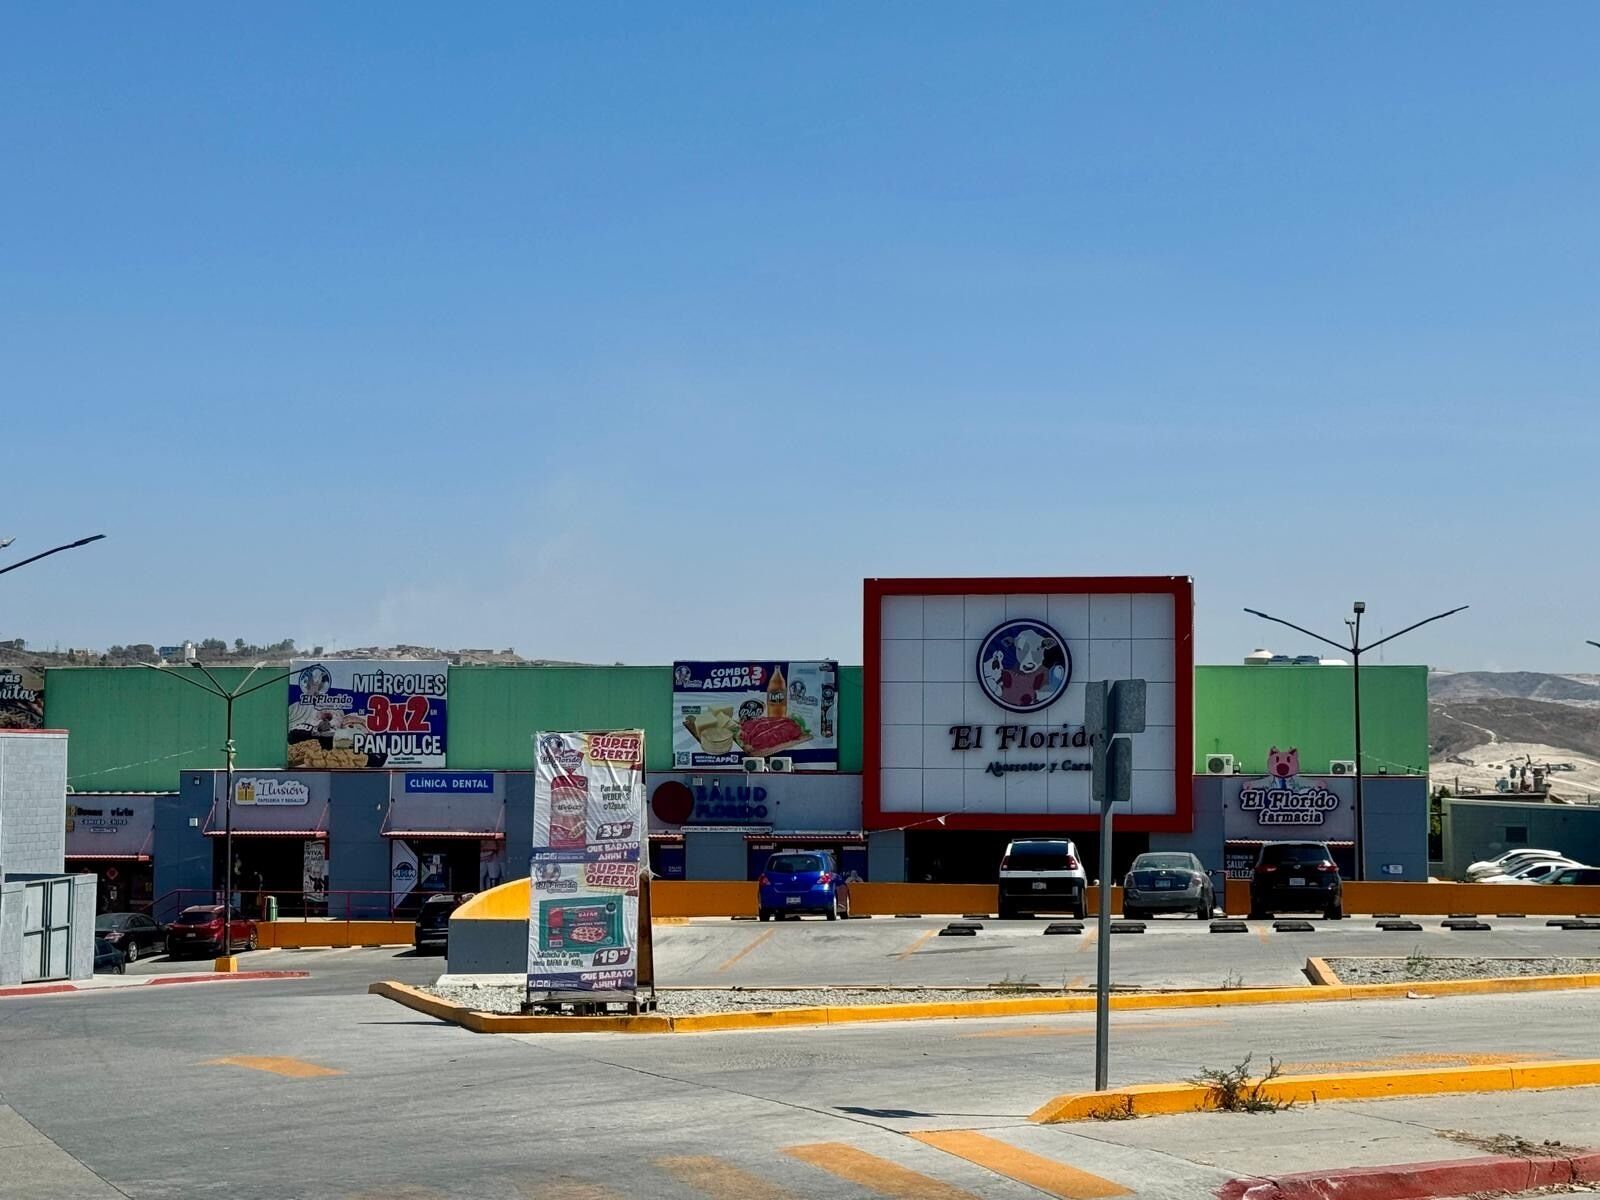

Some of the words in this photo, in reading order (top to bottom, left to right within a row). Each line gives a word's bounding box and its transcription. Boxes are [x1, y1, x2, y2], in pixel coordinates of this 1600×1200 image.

[710, 666, 749, 678] COMBO
[353, 669, 446, 696] MIÉRCOLES
[703, 677, 751, 690] ASADA
[300, 694, 314, 705] El
[315, 693, 353, 705] Florido
[366, 694, 431, 733] 3x2
[949, 725, 983, 751] El
[353, 734, 387, 755] PAN
[387, 735, 442, 756] DULCE
[589, 747, 640, 761] OFERTA
[715, 756, 731, 764] APP
[409, 777, 447, 788] CLÍNICA
[452, 779, 488, 788] DENTAL
[696, 786, 768, 801] SALUD
[1240, 789, 1265, 809] El
[1268, 788, 1338, 810] Florido
[1259, 809, 1323, 824] farmacia
[604, 842, 639, 851] BARATO
[586, 874, 637, 886] OFERTA
[598, 969, 634, 980] BARATO
